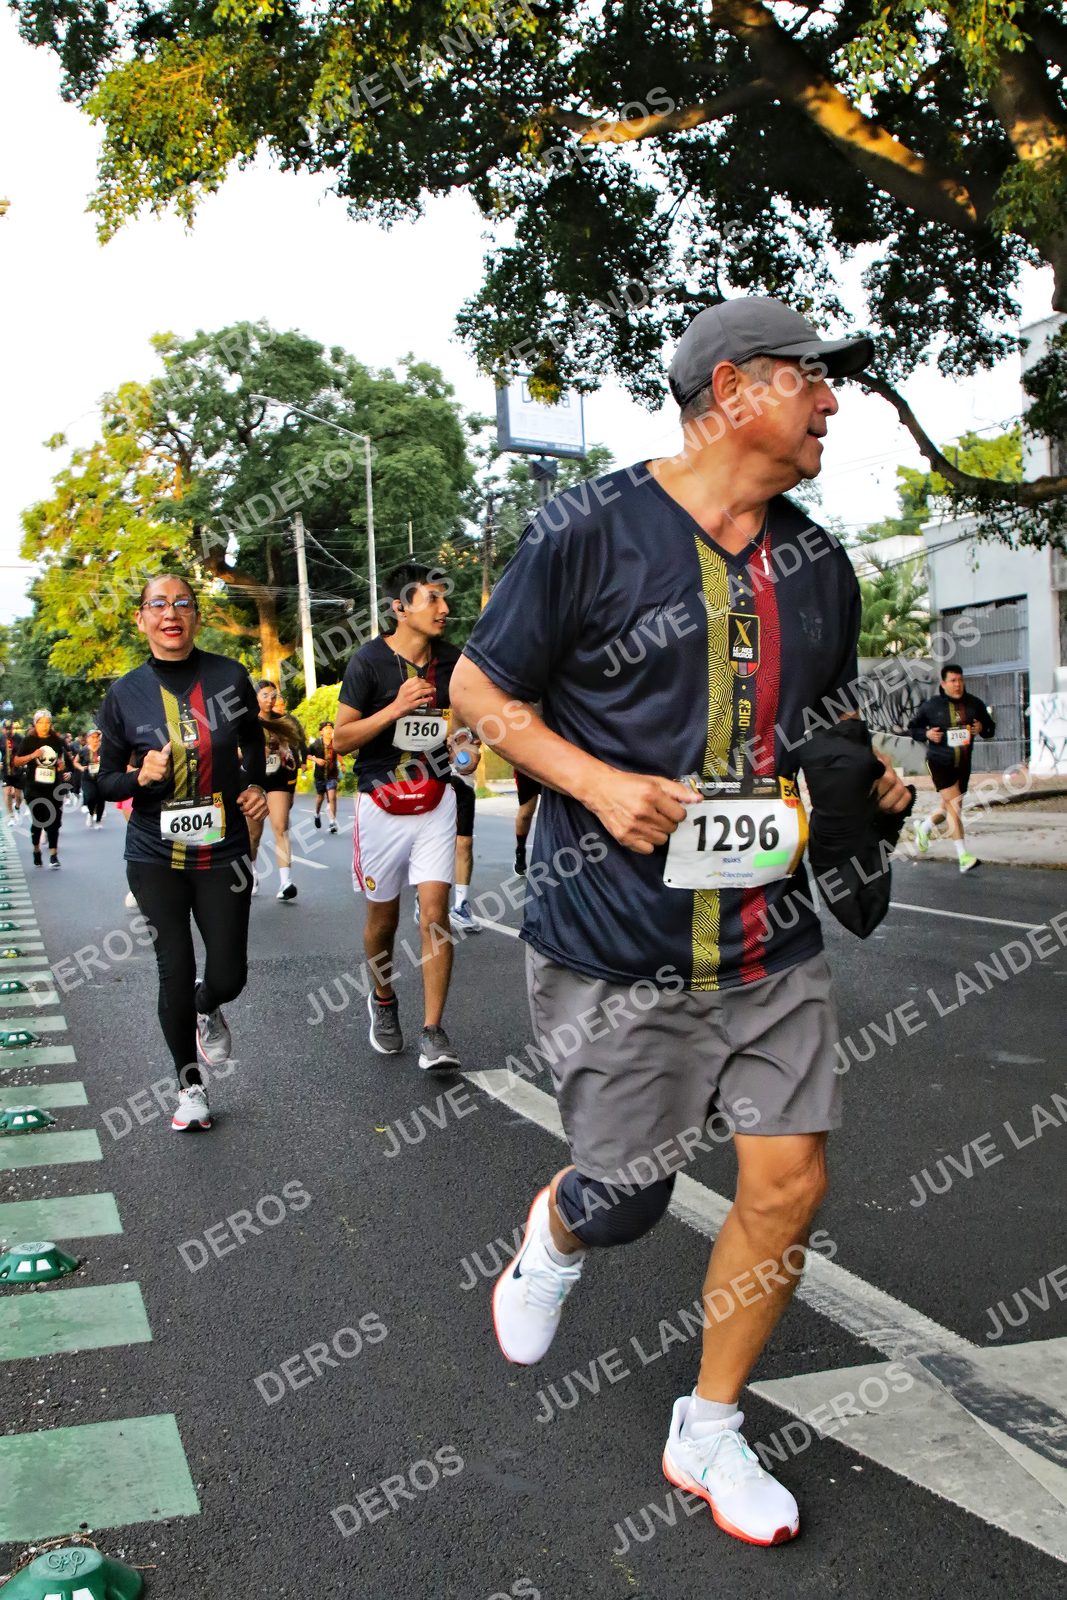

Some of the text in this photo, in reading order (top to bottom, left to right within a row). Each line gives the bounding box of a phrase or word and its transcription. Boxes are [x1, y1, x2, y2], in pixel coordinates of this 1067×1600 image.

[404, 721, 439, 737] 1360
[170, 812, 213, 833] 6804
[693, 814, 779, 851] 1296
